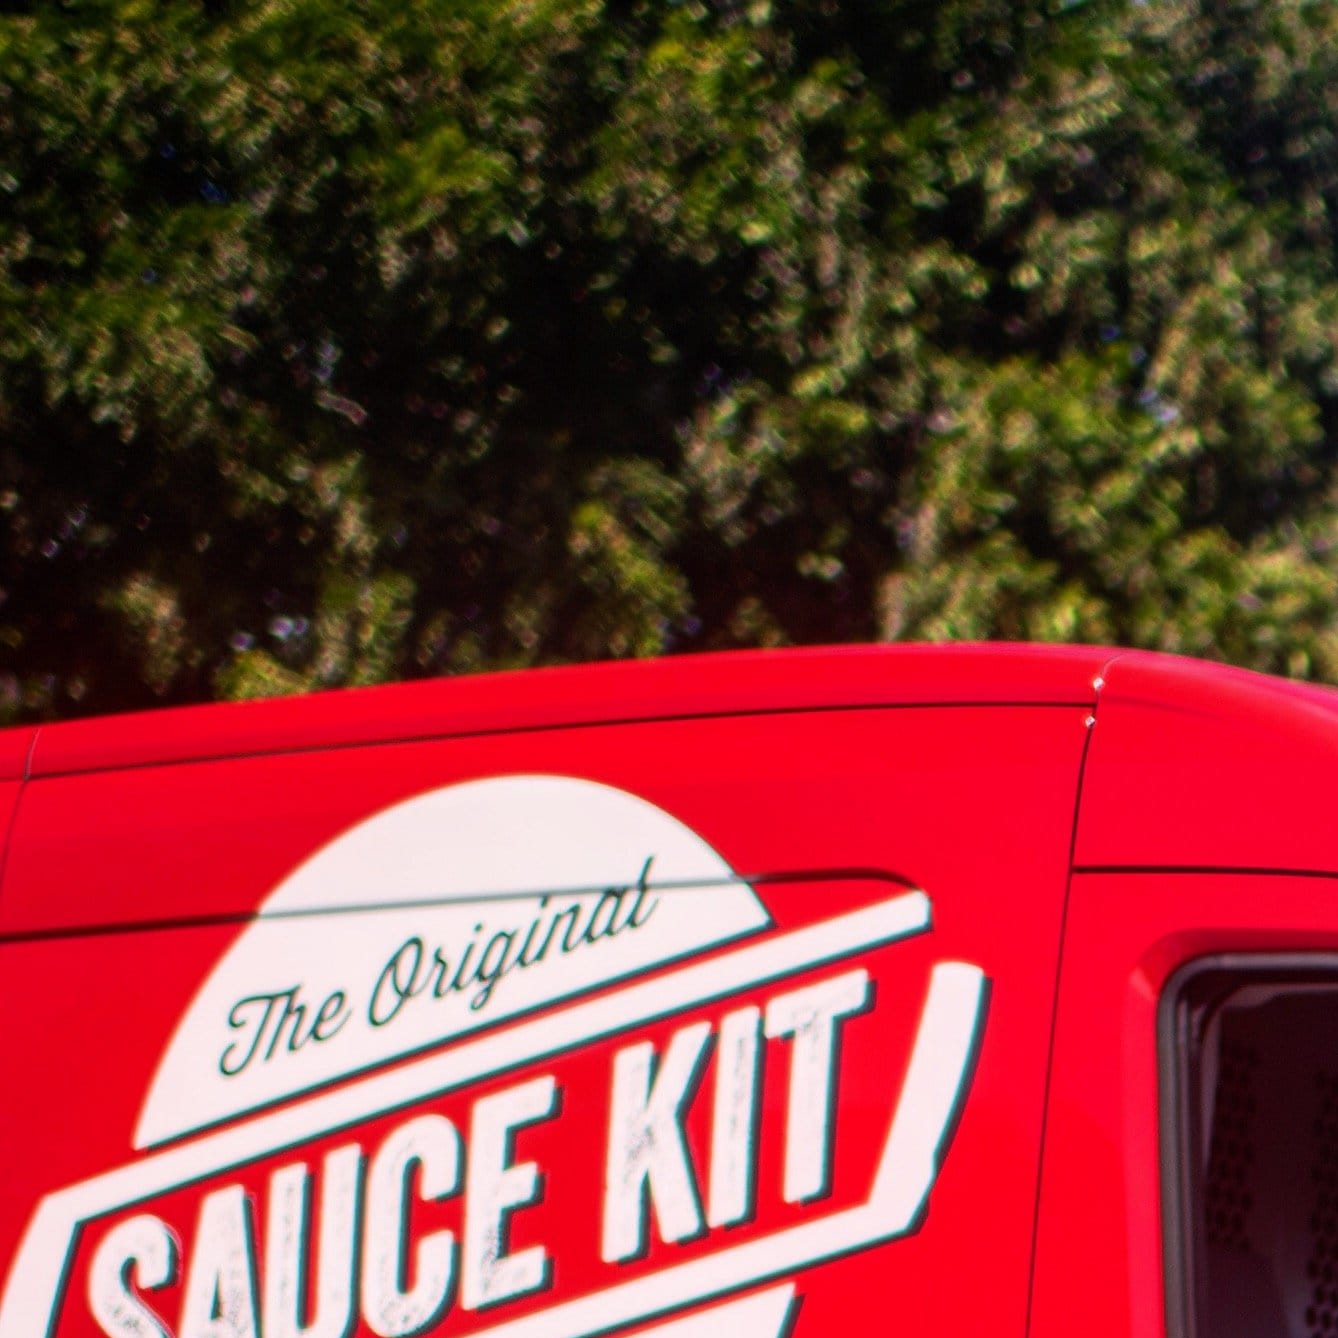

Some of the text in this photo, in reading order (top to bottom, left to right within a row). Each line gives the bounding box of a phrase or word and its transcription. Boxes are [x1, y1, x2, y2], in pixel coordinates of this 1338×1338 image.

[220, 855, 660, 1077] The Original
[602, 968, 877, 1263] KIT
